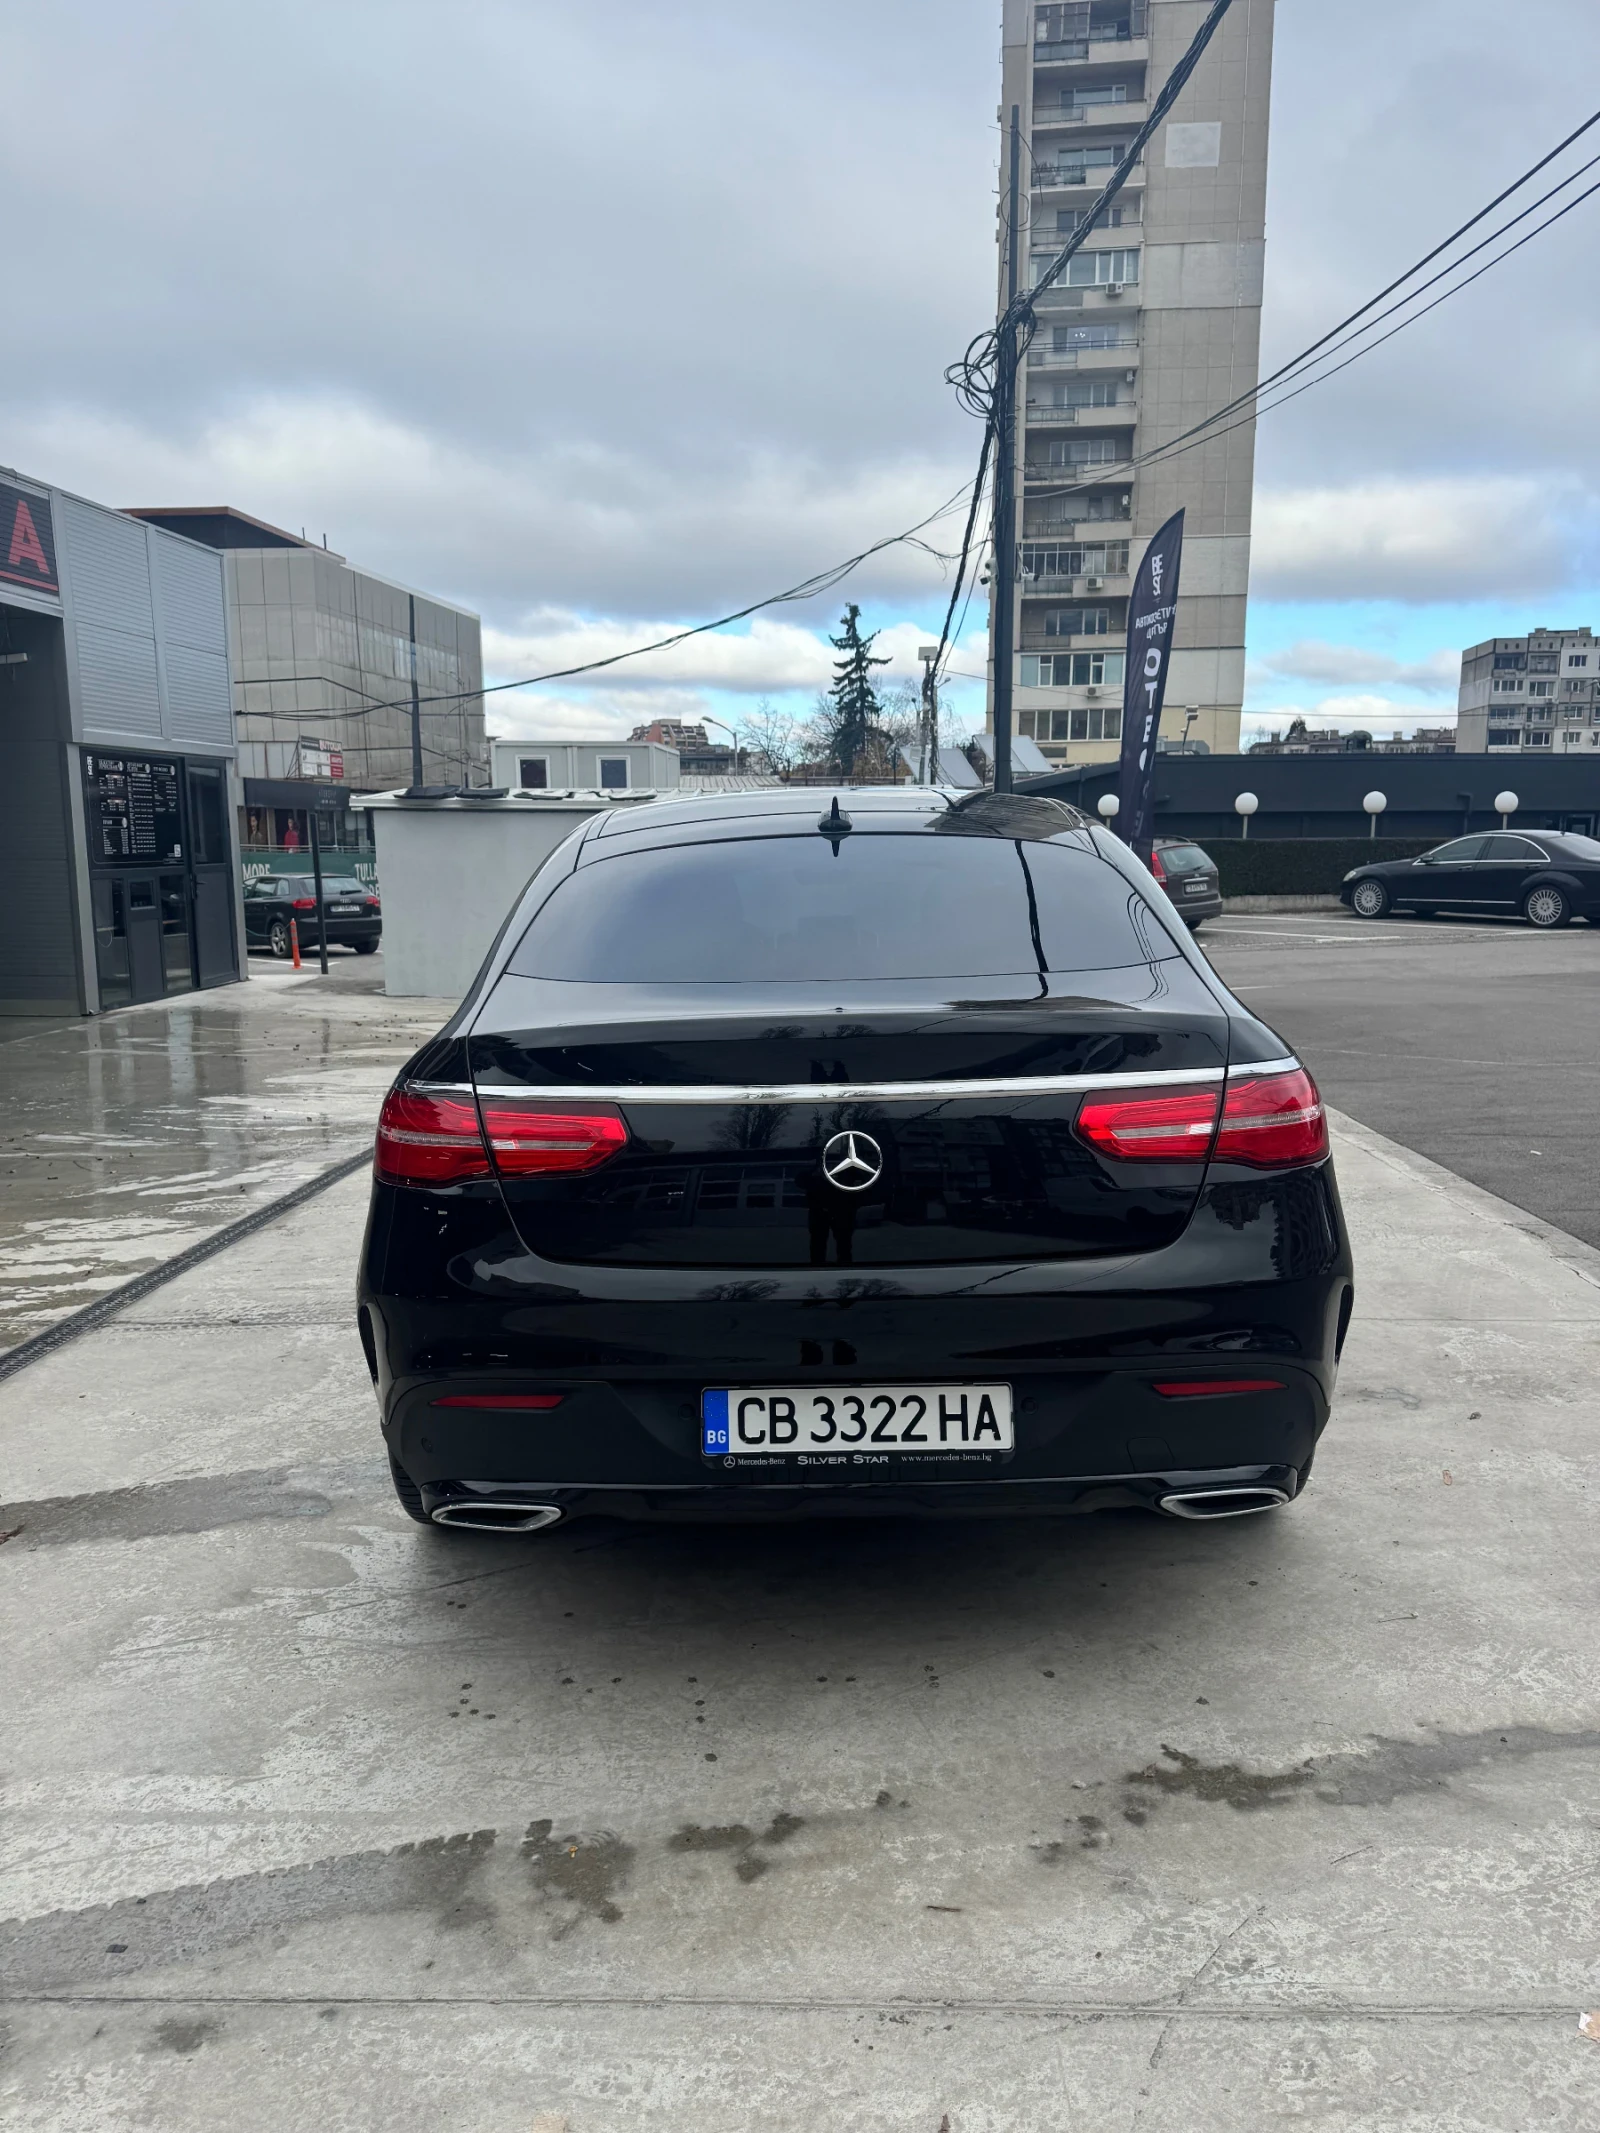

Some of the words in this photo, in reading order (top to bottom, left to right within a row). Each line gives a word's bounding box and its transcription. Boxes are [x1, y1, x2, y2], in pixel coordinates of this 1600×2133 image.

[737, 1396, 799, 1445] CB
[810, 1395, 928, 1444] 3322
[938, 1394, 1002, 1442] HA
[706, 1429, 727, 1444] BG
[737, 1457, 786, 1466] Mercedes-Benz
[797, 1455, 848, 1465] SILVER
[853, 1454, 889, 1464] STAR
[901, 1453, 992, 1463] www.mercedes-benz.bg
